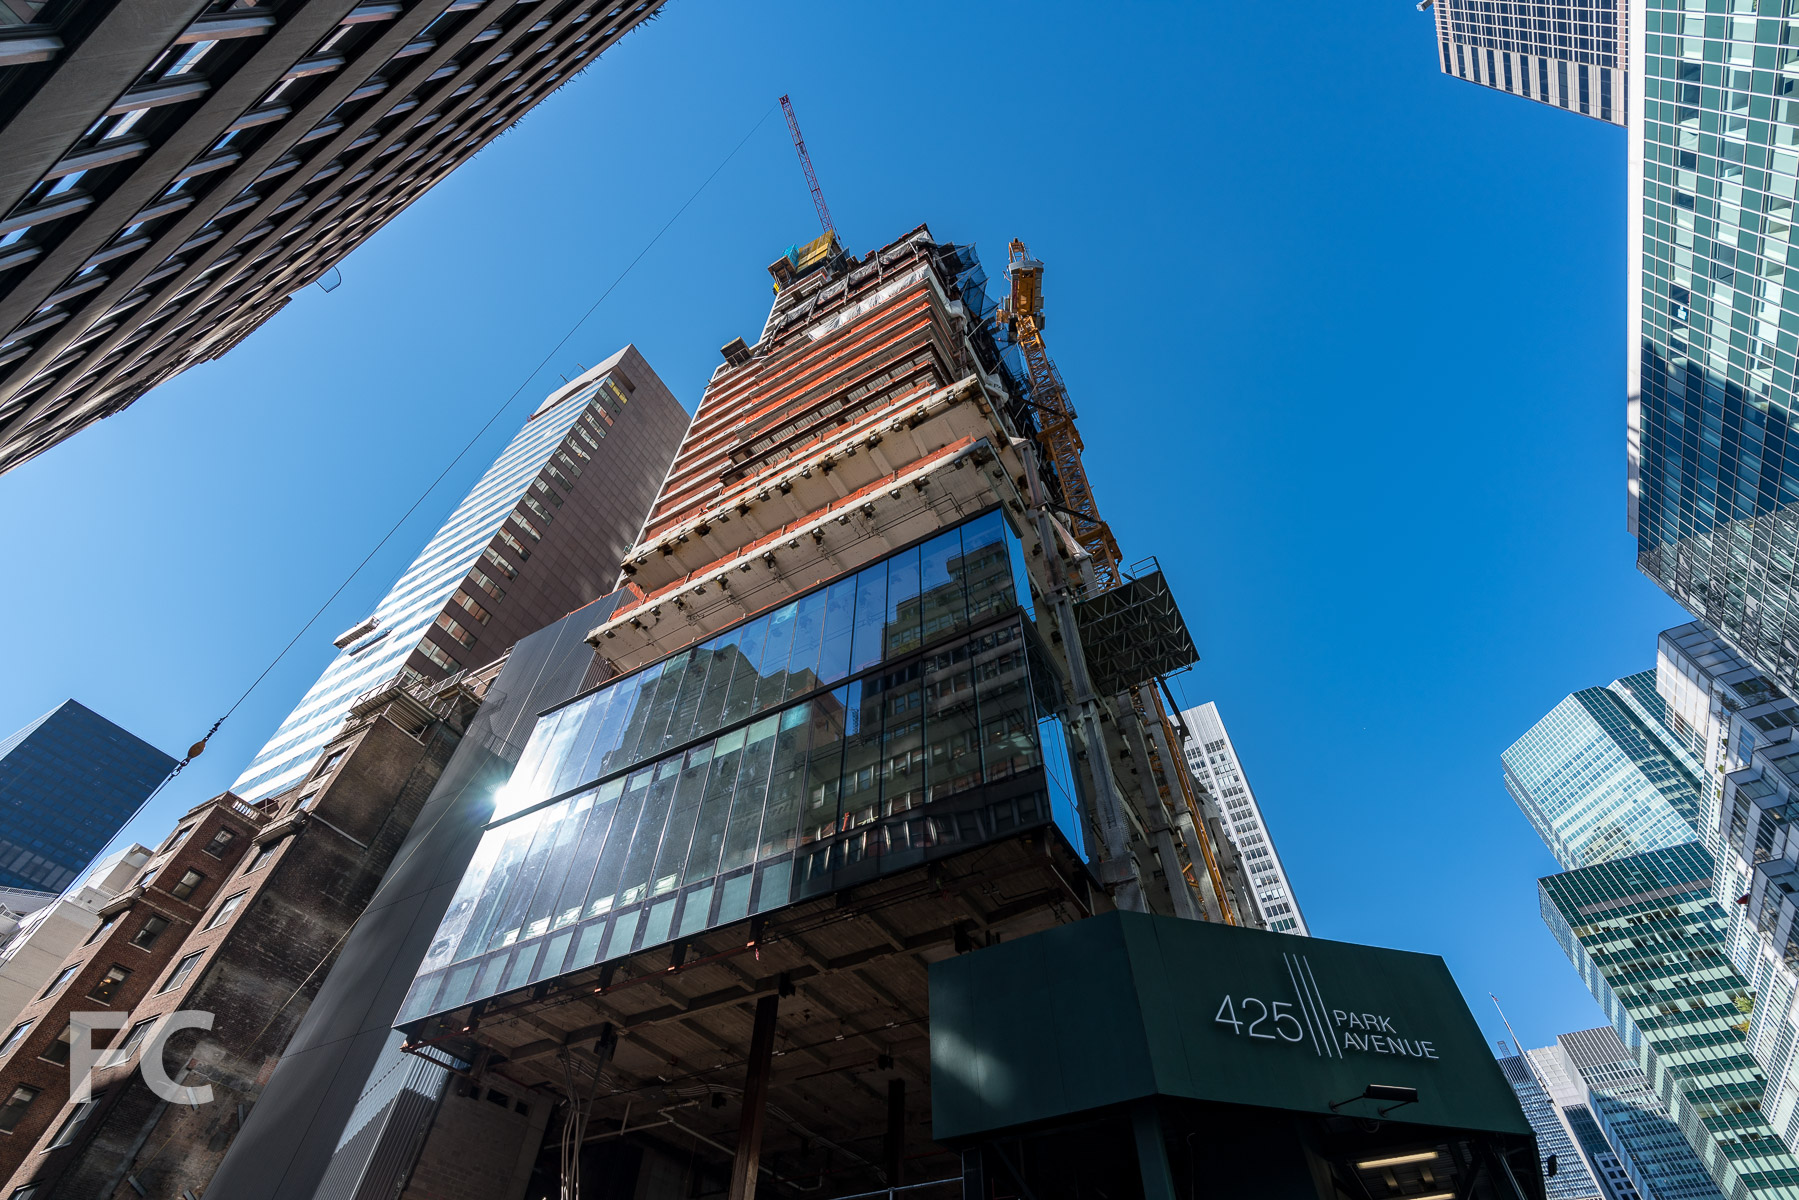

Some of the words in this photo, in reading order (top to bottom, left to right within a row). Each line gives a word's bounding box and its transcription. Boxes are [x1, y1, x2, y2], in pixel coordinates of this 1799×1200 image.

[1215, 994, 1303, 1042] 425
[1333, 1009, 1397, 1034] PARK
[1343, 1031, 1439, 1059] AVENUE
